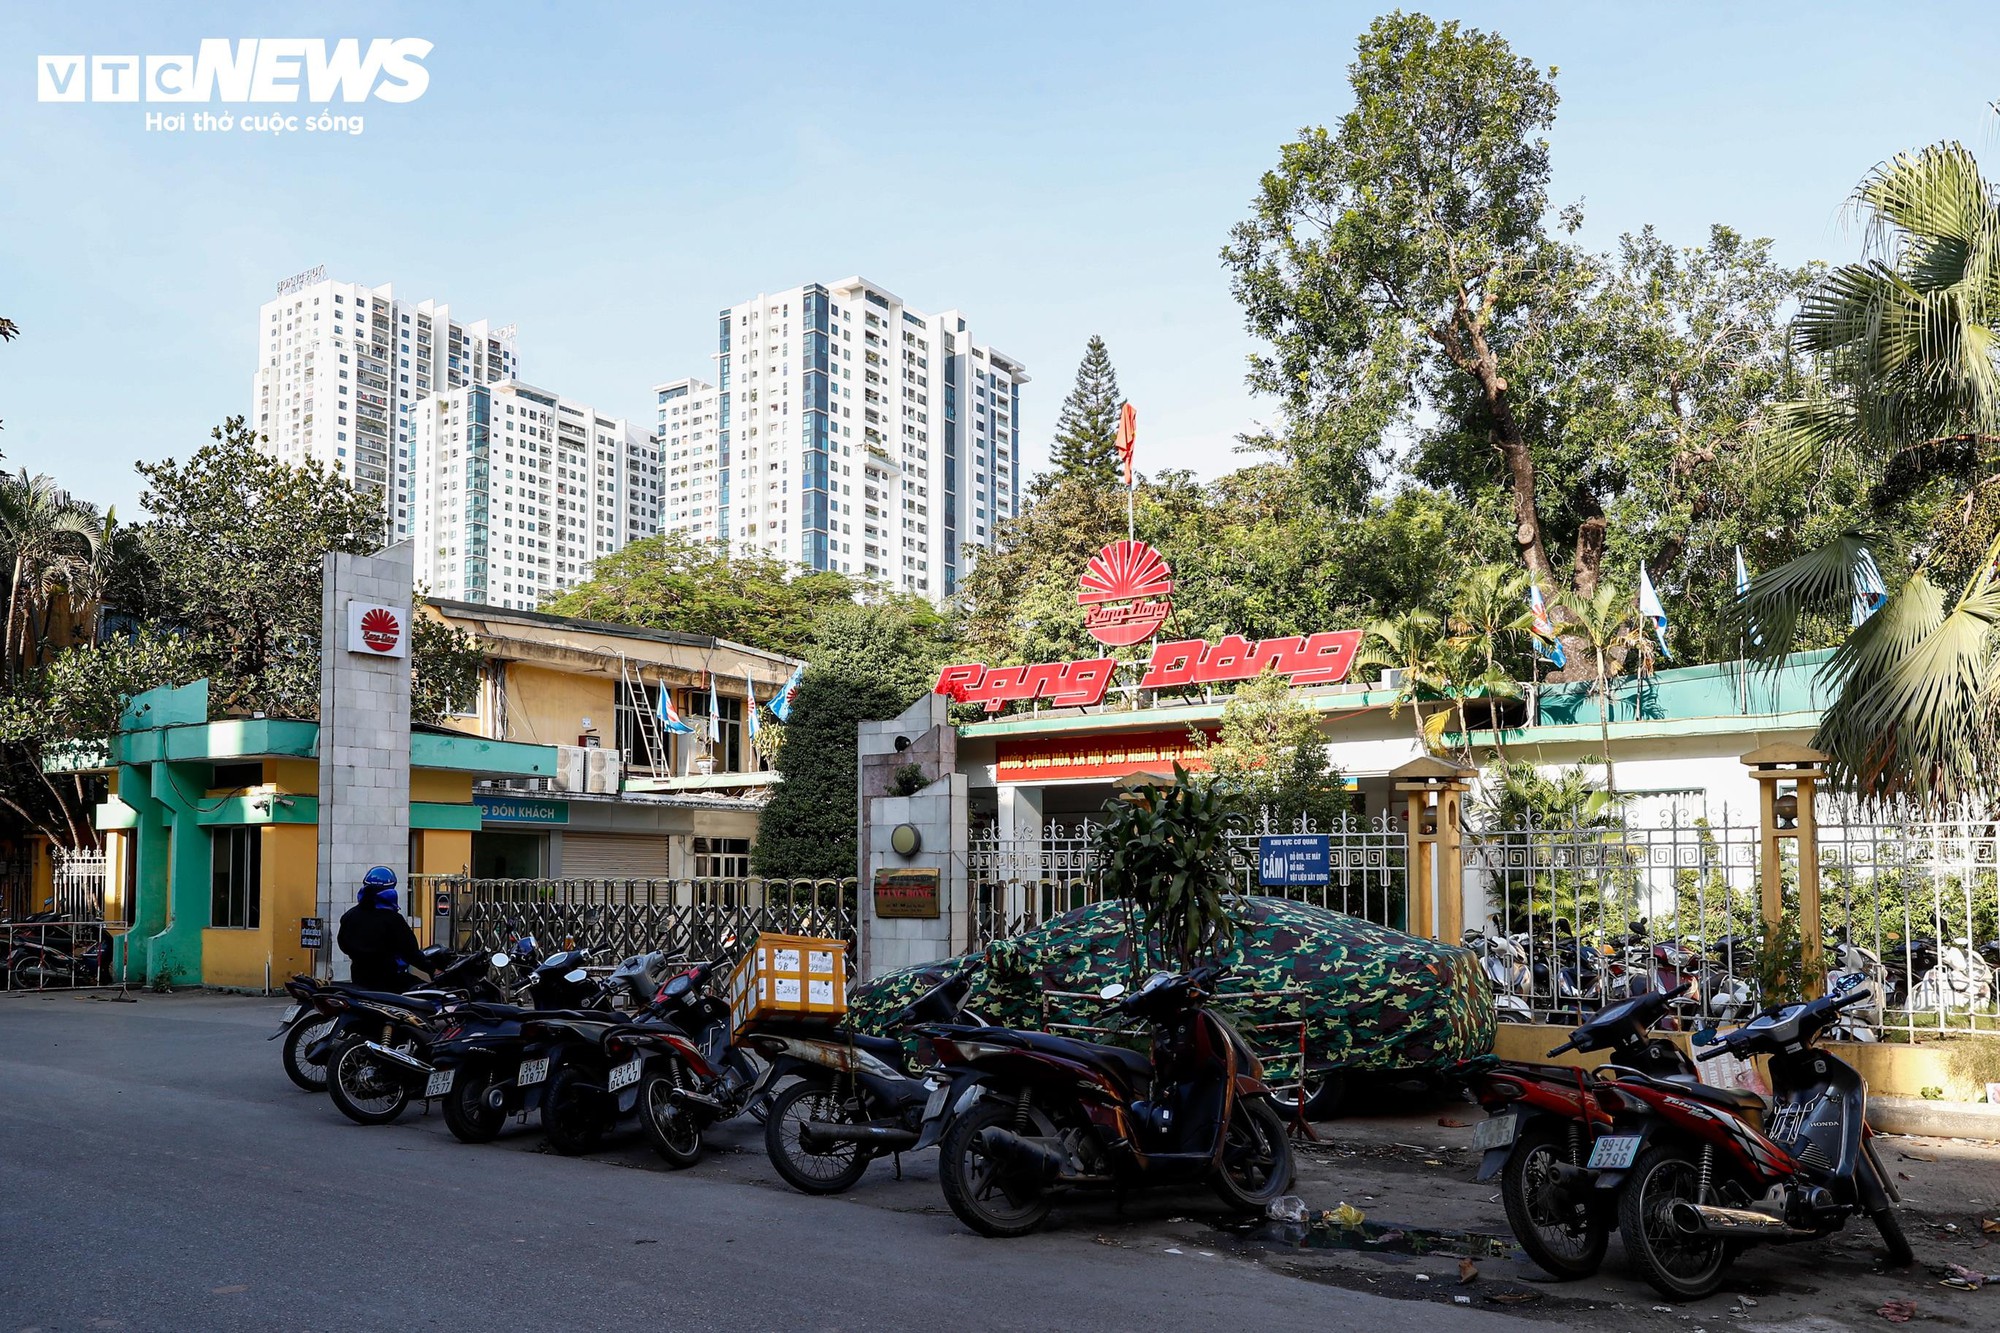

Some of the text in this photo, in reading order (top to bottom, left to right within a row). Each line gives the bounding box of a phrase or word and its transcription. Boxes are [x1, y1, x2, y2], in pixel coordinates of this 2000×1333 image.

[1026, 751, 1051, 770] CỘNG
[1073, 748, 1086, 766] XÃ
[1087, 748, 1104, 767] HỘI
[1105, 744, 1126, 764] CHỦ
[1128, 744, 1158, 763] NGHĨA
[1160, 743, 1181, 761] VIỆT
[491, 803, 515, 817] ĐÓN
[518, 804, 555, 819] KHÁCH
[1282, 838, 1293, 846] VỰC
[1302, 838, 1318, 846] QUAN
[1262, 850, 1284, 879] CẤM
[613, 1062, 637, 1079] 29-P1
[610, 1072, 638, 1090] 044.47
[1600, 1138, 1631, 1152] 99-L4
[1594, 1152, 1628, 1167] 3796
